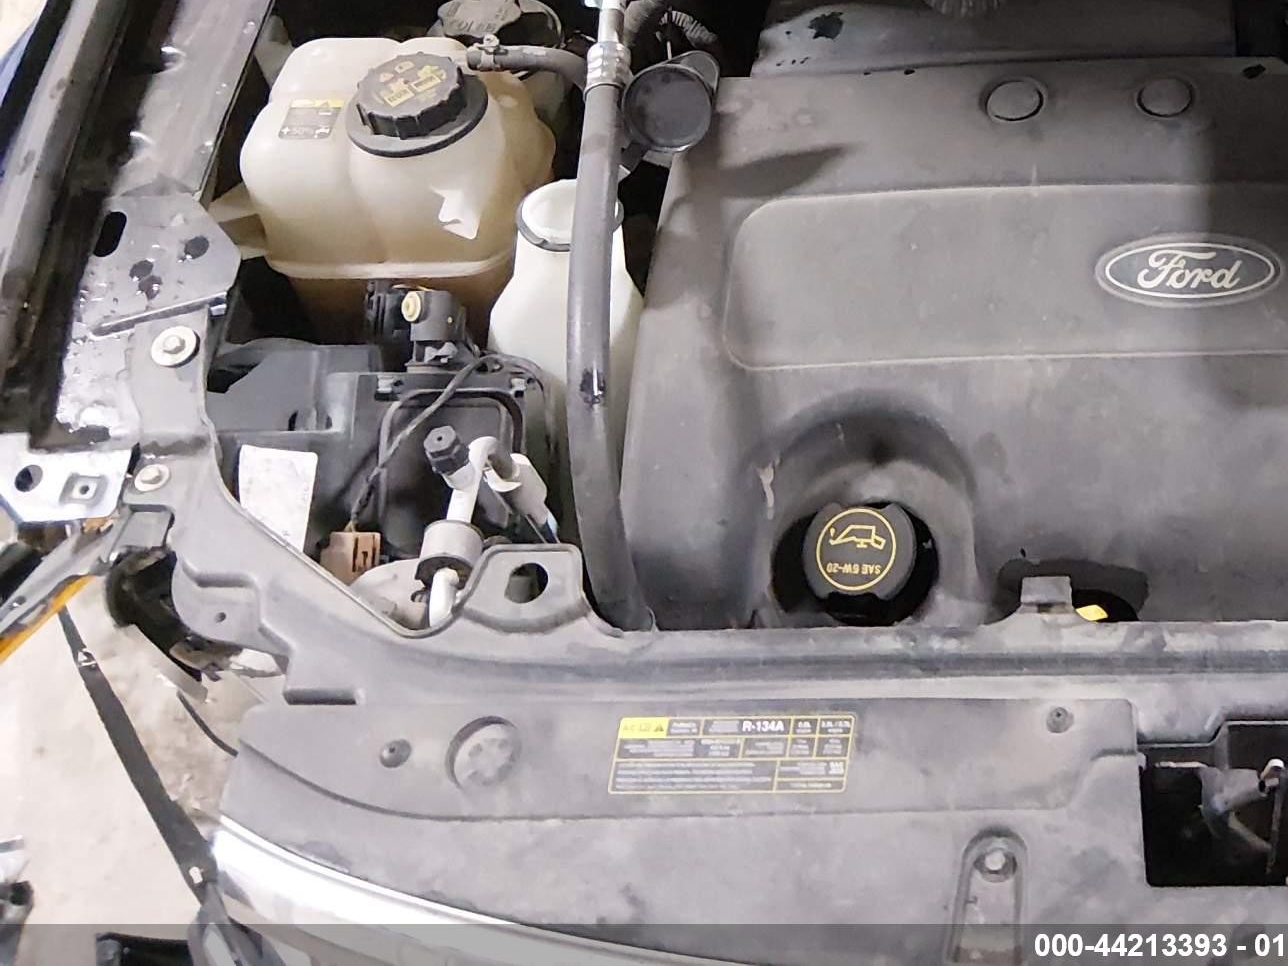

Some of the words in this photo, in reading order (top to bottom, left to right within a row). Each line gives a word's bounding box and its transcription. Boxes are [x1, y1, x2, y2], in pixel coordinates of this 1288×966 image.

[1136, 249, 1242, 289] Ford
[861, 563, 881, 575] SAE
[742, 720, 784, 732] R-134A
